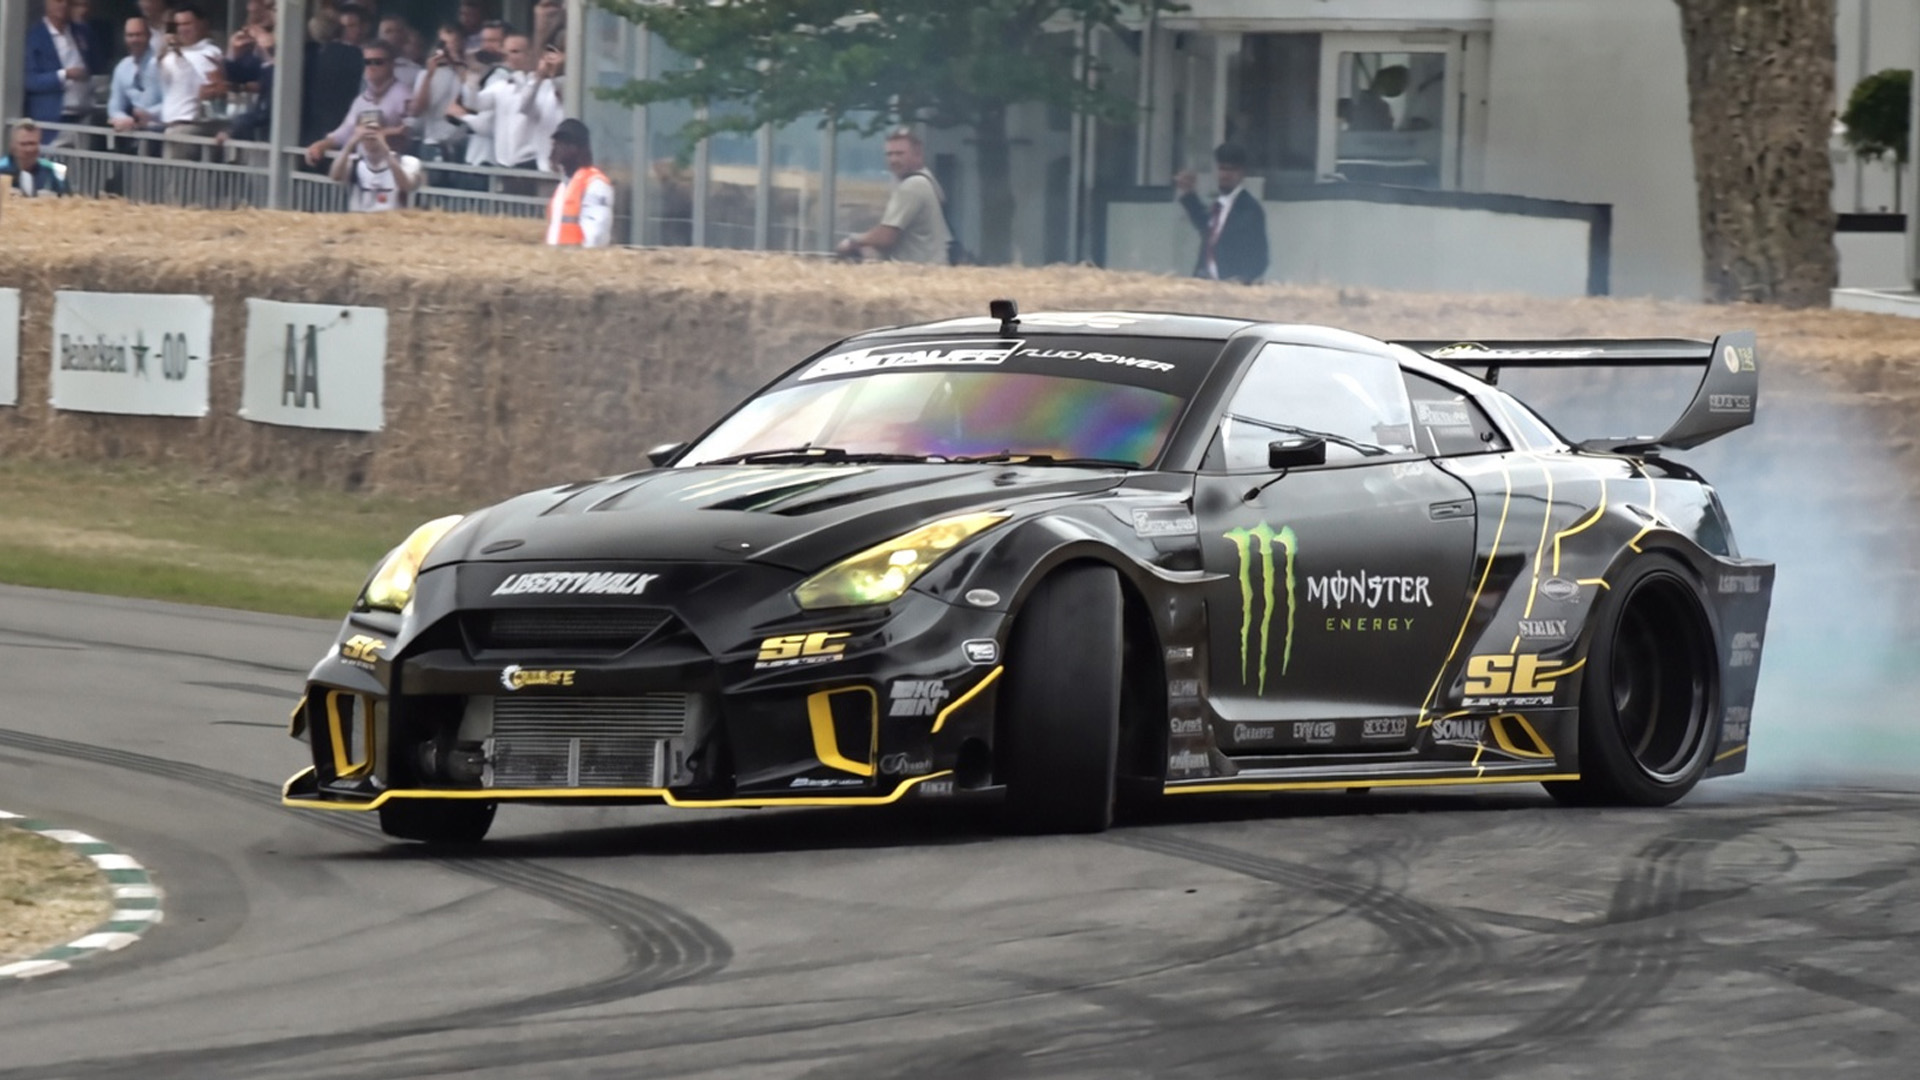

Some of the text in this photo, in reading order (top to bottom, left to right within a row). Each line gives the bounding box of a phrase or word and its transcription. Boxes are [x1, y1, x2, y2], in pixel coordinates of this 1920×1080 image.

[281, 323, 320, 409] AA
[1079, 352, 1175, 372] POWER
[1307, 569, 1433, 609] MONSTER
[1325, 618, 1414, 631] ENERGY
